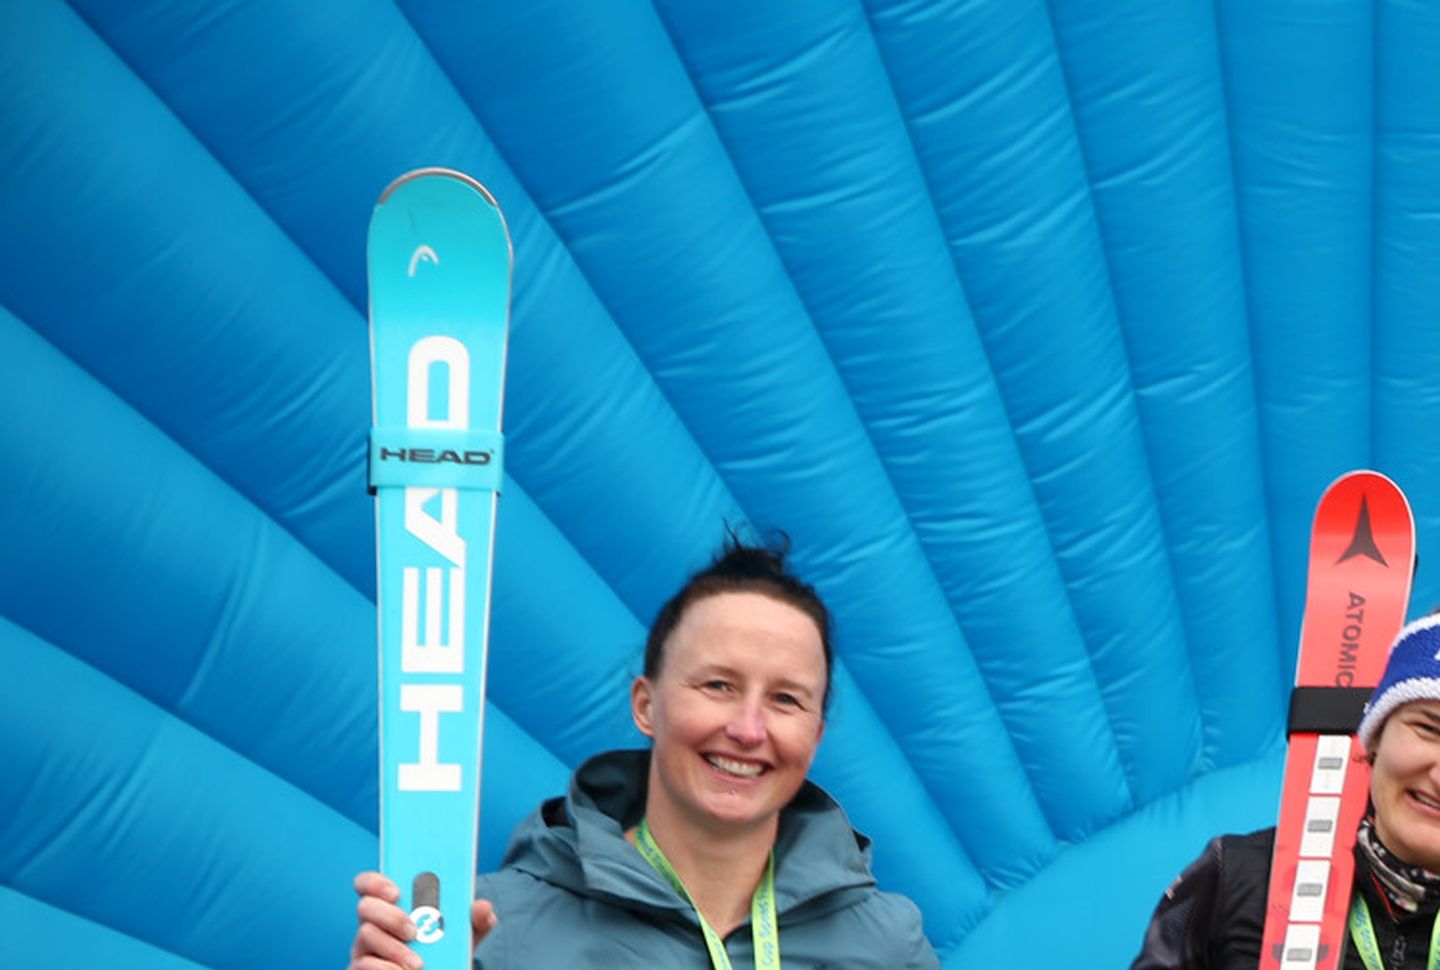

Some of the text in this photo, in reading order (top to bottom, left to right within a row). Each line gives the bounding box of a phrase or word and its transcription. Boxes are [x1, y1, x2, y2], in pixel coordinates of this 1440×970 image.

[380, 447, 491, 466] HEAD
[397, 336, 470, 792] HEAD
[1334, 591, 1366, 688] ATOMIC
[759, 943, 775, 966] Cup
